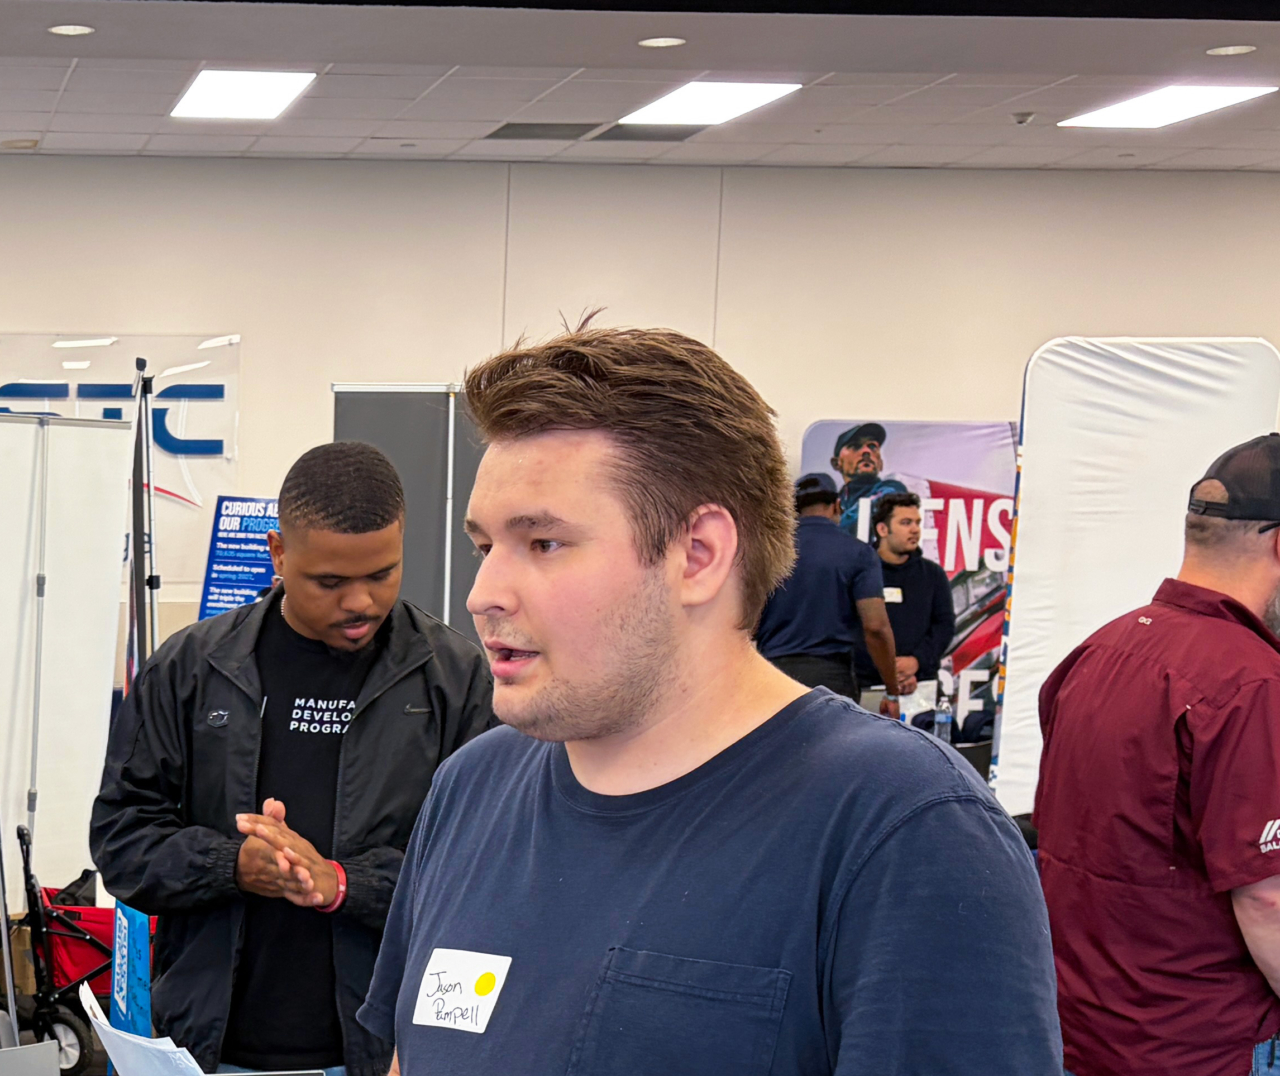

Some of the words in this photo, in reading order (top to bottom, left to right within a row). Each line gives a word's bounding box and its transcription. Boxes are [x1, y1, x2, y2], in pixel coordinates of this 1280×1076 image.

[221, 501, 266, 517] CURIOUS
[218, 516, 241, 531] OUR
[294, 698, 356, 710] MANUFA
[292, 709, 352, 722] DEVELO
